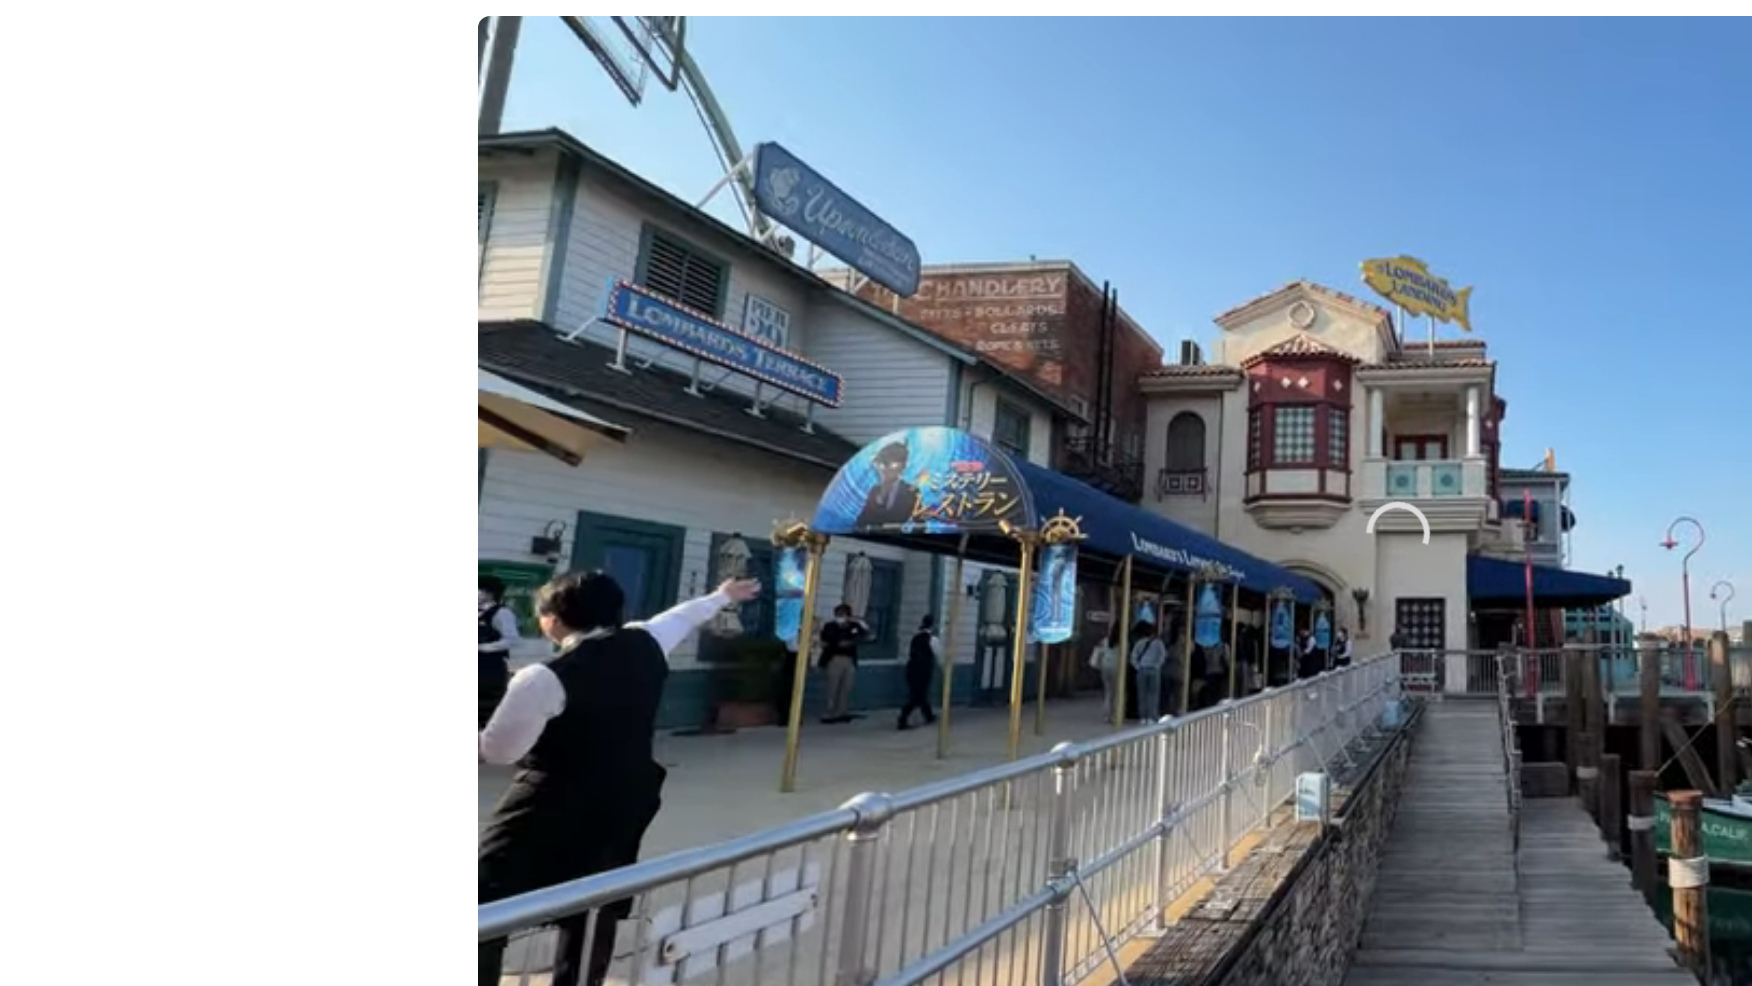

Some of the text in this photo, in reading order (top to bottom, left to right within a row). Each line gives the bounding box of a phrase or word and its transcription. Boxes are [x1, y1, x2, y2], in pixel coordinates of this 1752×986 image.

[911, 491, 1020, 518] レストラン
